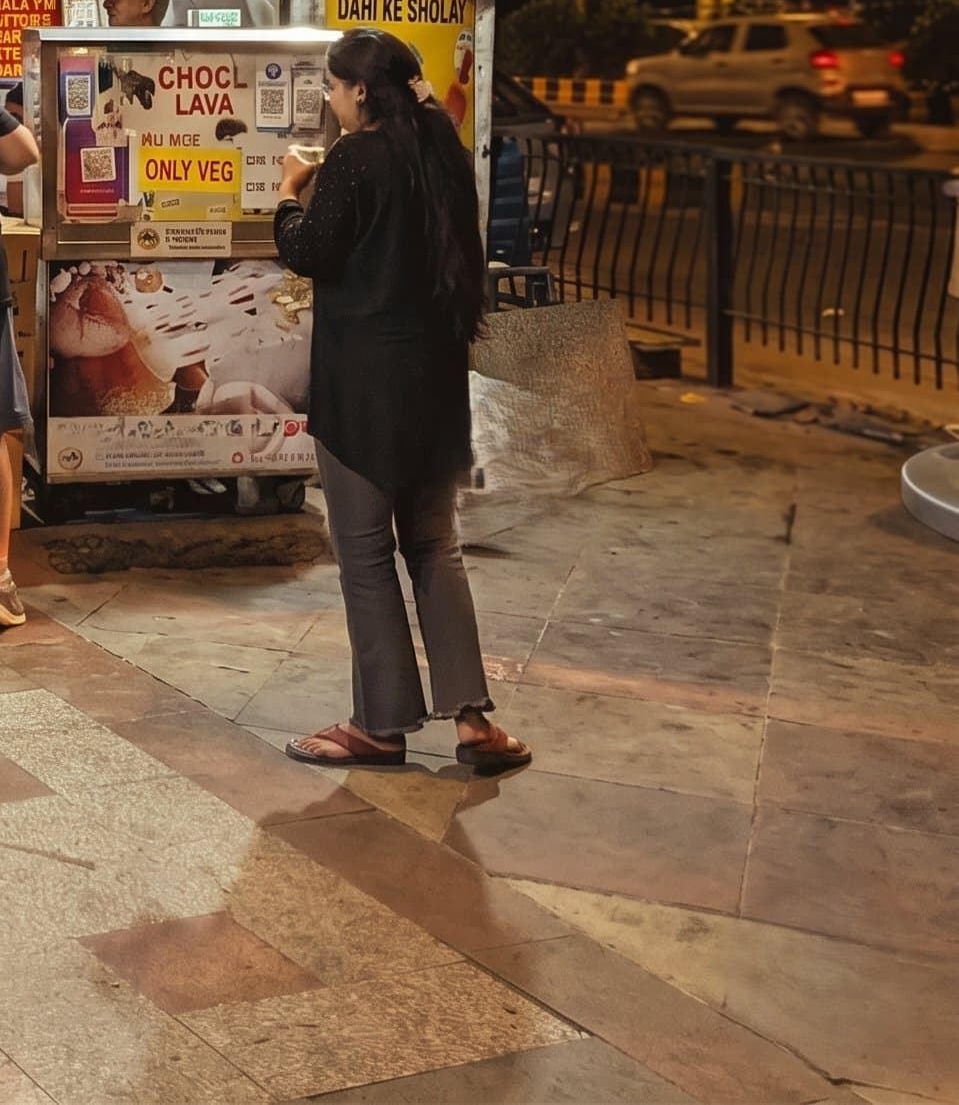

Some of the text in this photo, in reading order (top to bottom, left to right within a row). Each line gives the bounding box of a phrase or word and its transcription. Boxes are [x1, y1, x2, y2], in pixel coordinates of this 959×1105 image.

[175, 93, 235, 116] LAVA
[145, 158, 193, 182] ONLY
[197, 159, 234, 183] VEG
